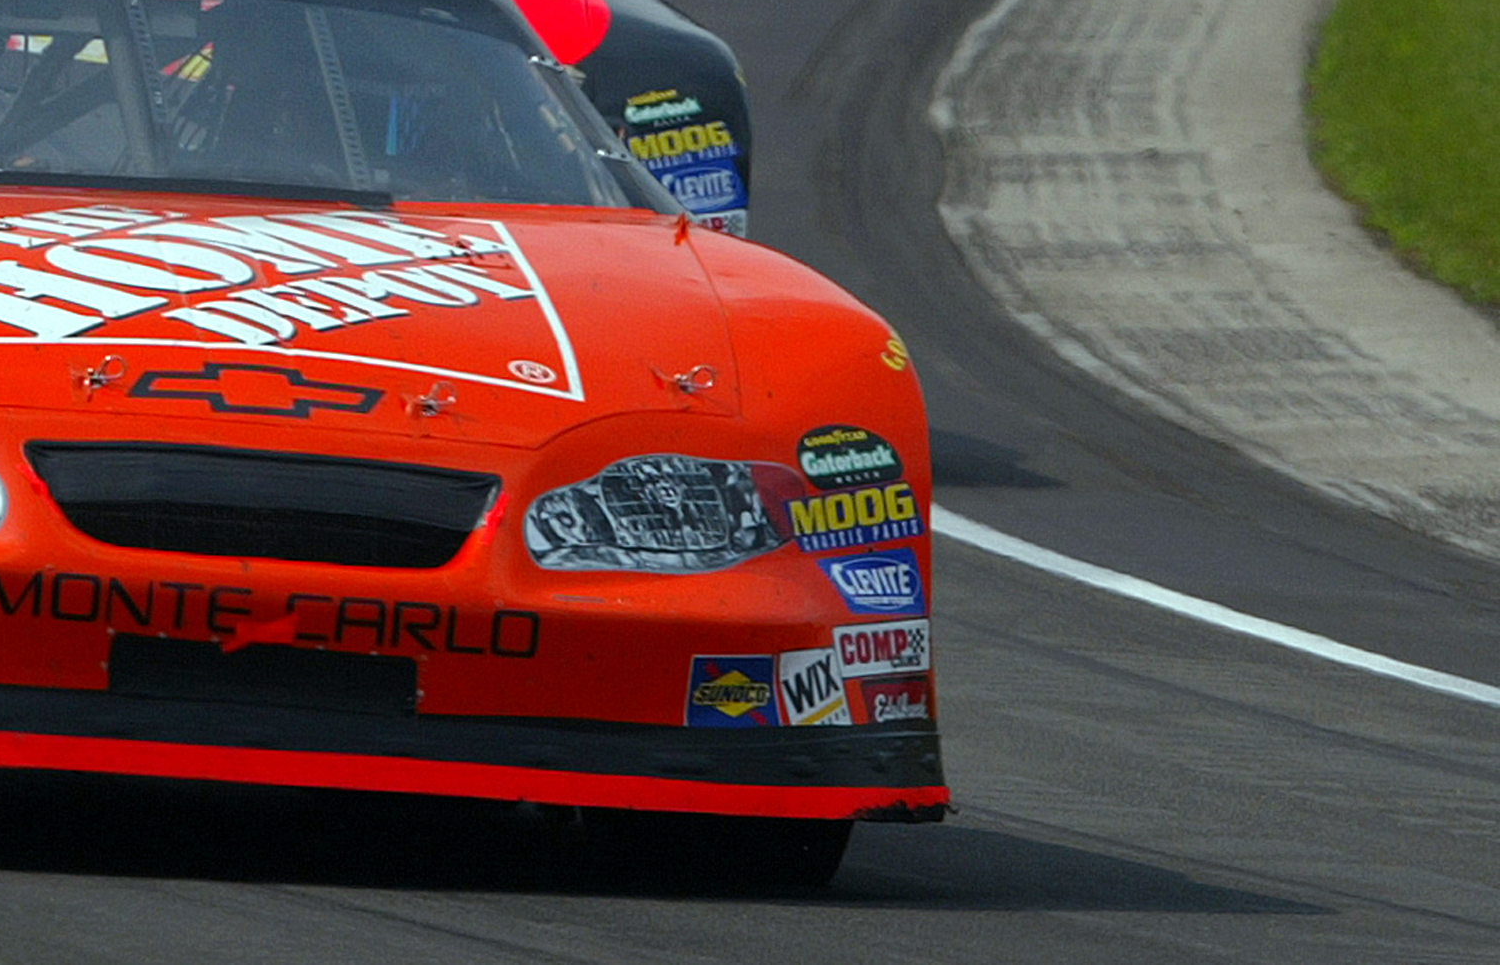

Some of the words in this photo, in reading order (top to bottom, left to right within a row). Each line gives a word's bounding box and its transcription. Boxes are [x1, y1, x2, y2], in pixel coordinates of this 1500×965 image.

[629, 121, 732, 159] MOOG
[161, 262, 537, 347] DEPOT
[800, 444, 897, 477] Gatorback
[789, 483, 916, 535] MOOG
[830, 562, 913, 596] CLEVITE
[286, 592, 542, 660] CARLO
[839, 629, 908, 666] COMP
[782, 653, 840, 714] WIX
